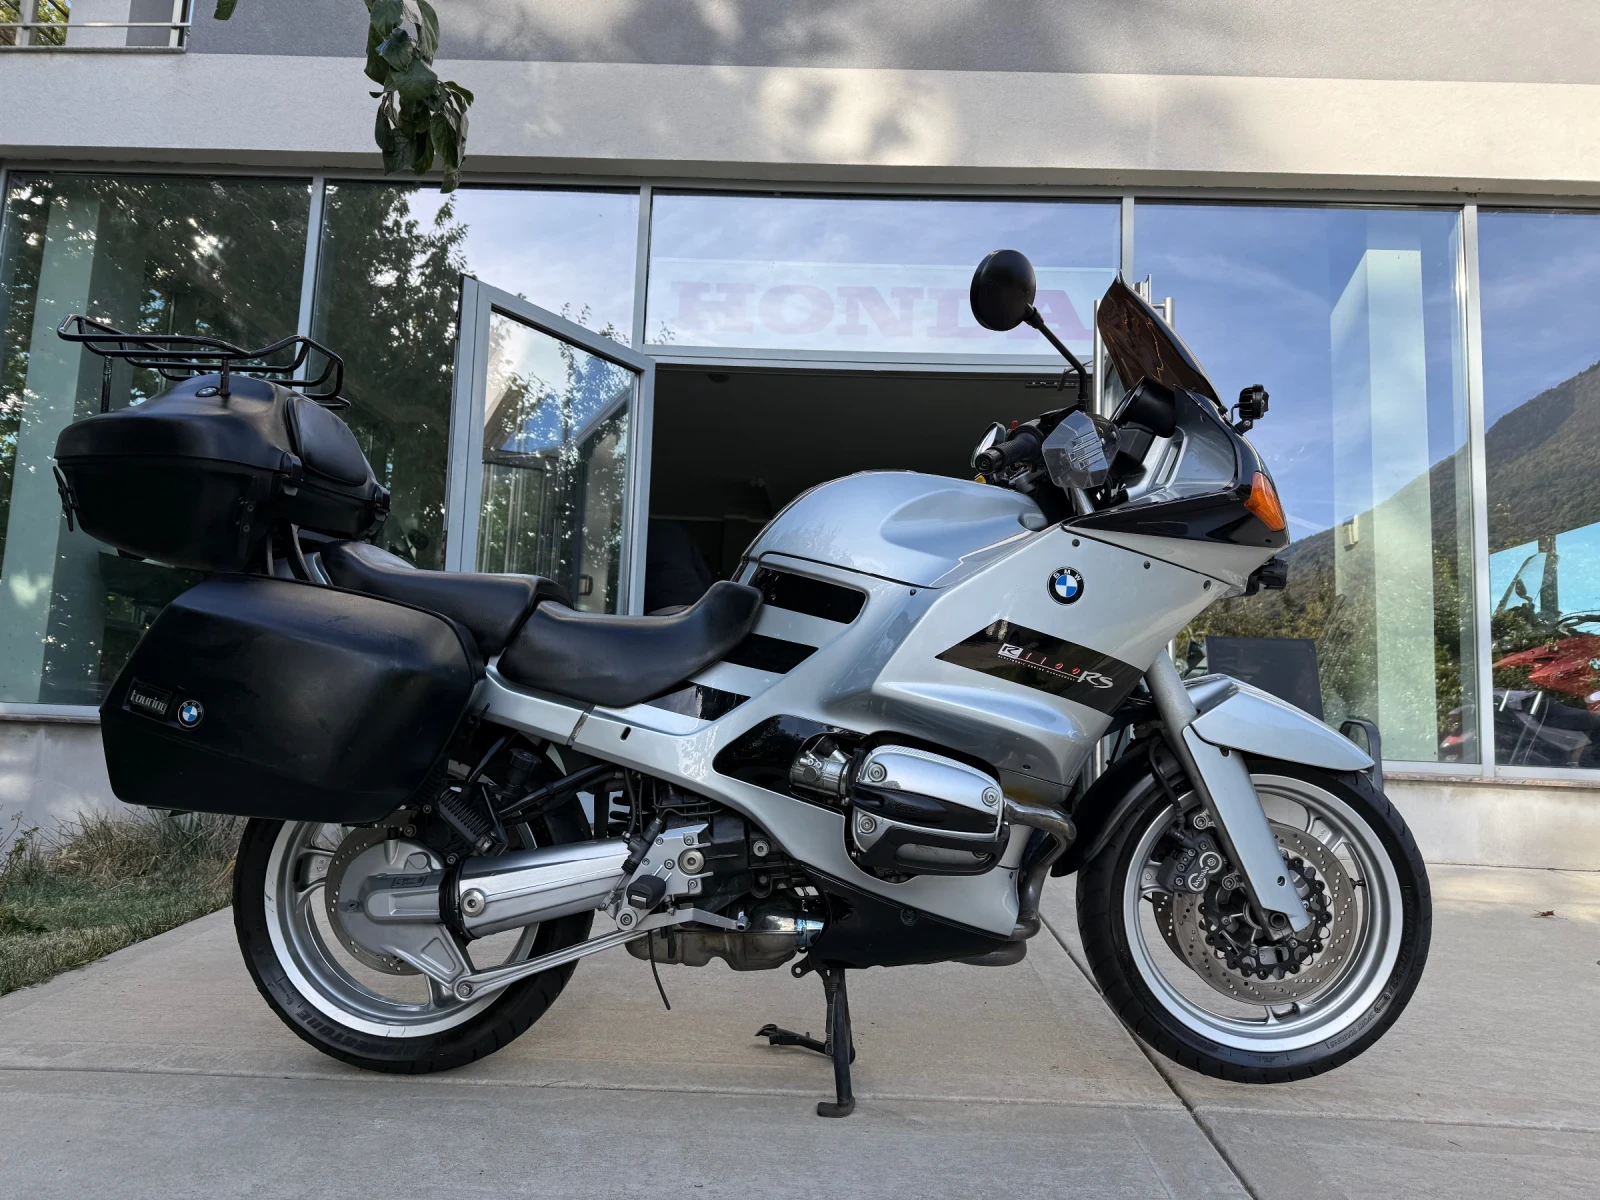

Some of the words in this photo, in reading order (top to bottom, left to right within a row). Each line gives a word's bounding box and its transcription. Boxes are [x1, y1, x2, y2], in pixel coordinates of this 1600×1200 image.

[1025, 652, 1080, 675] 1100
[1077, 671, 1114, 689] RS
[130, 689, 168, 715] touring
